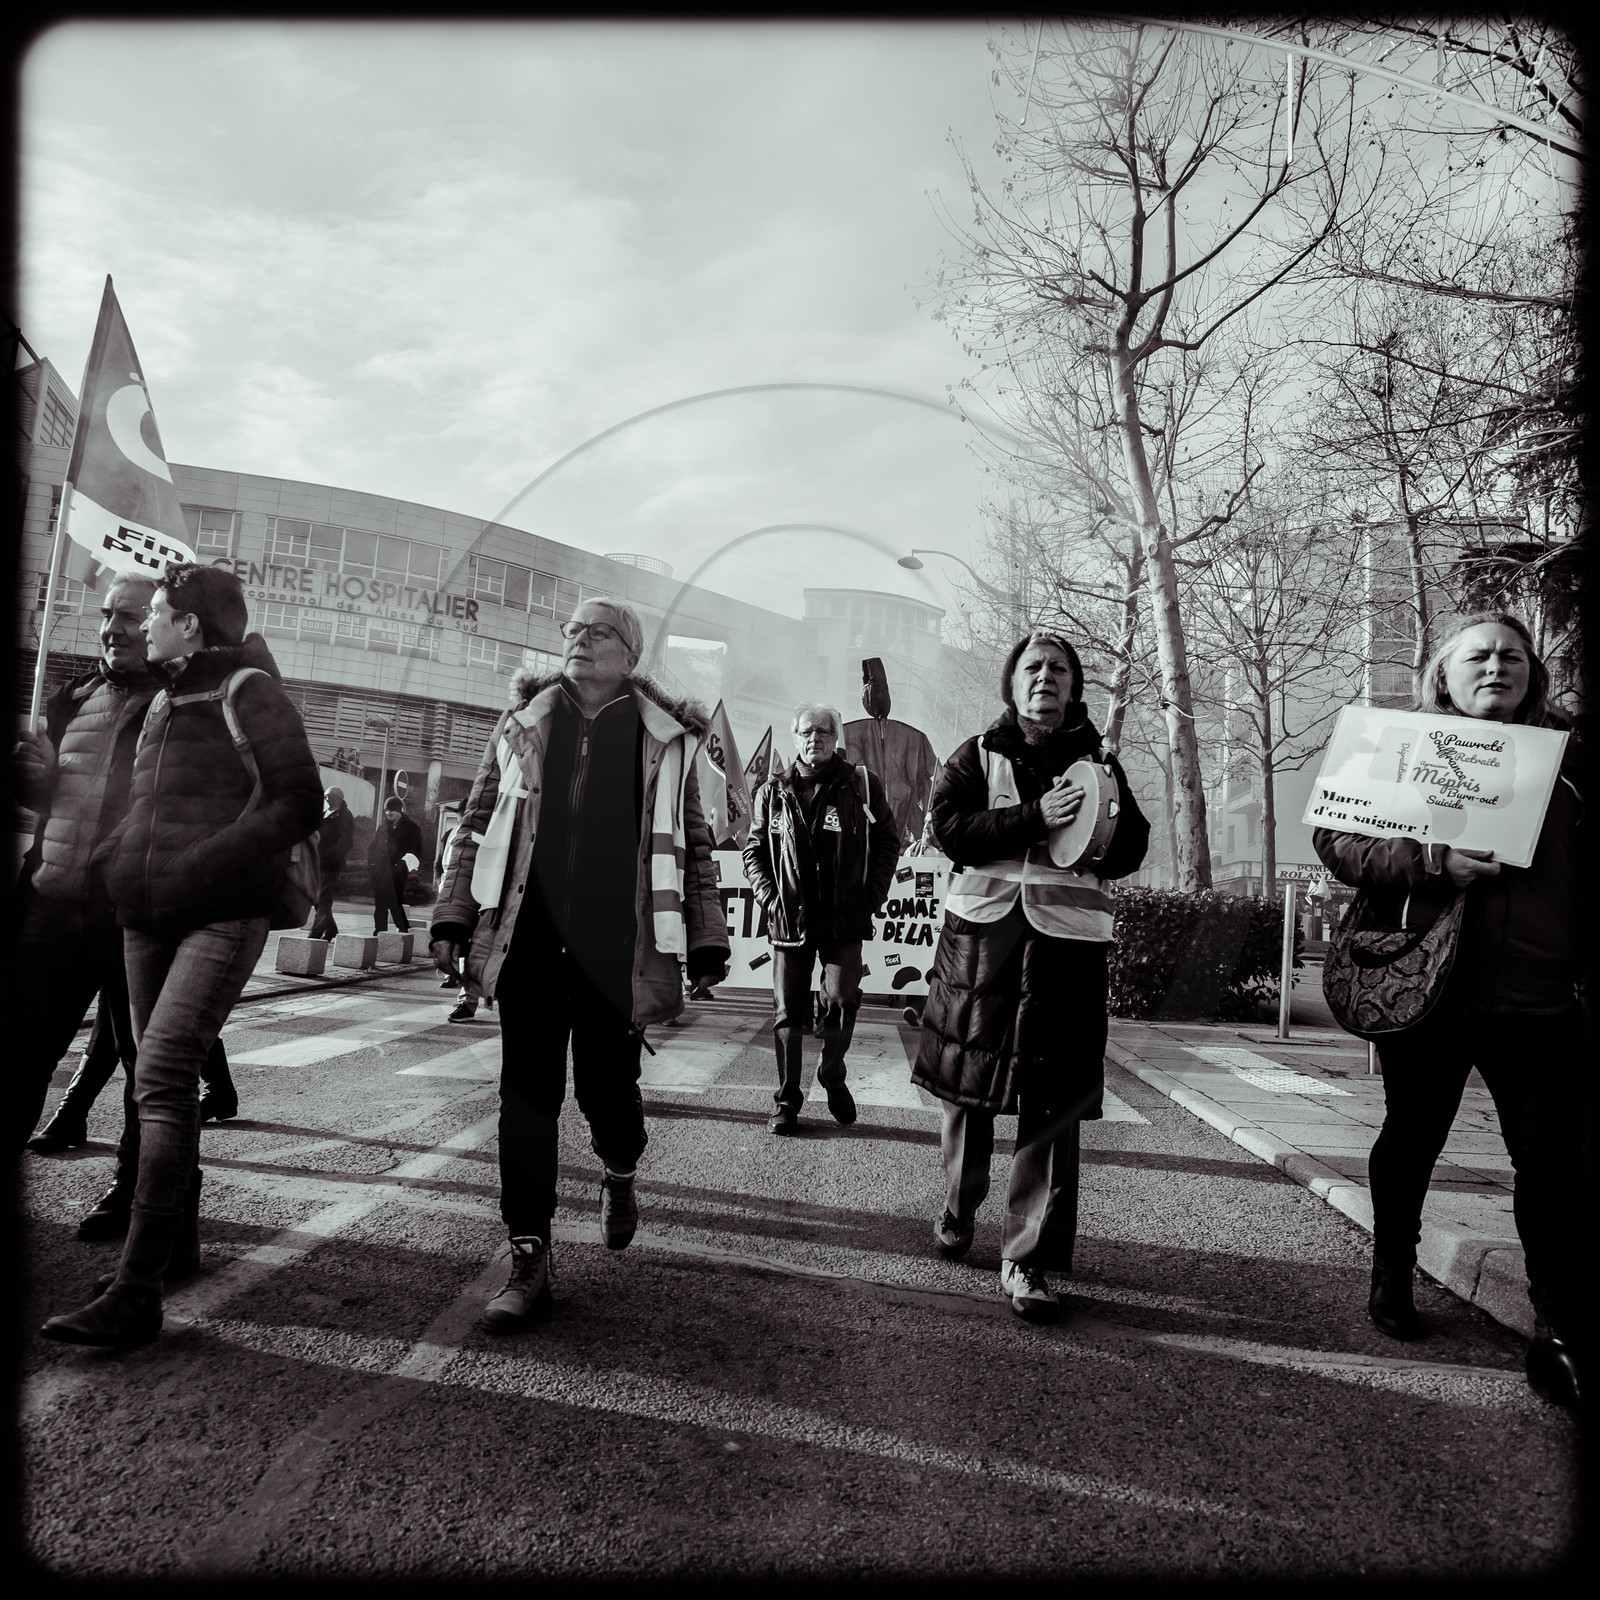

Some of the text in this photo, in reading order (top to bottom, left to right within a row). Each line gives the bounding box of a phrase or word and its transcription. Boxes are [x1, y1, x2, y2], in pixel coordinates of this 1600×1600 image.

[117, 525, 184, 562] Fin
[326, 573, 479, 621] HOSPITALIER
[242, 590, 478, 633] communal des Alpes du Sud
[1429, 730, 1467, 780] Souffrance
[1444, 734, 1506, 753] Pauvreté
[1455, 752, 1501, 768] Retraite
[1413, 767, 1480, 794] Mépris
[1319, 790, 1372, 807] Marre
[1427, 795, 1464, 810] Suicide
[1447, 788, 1499, 805] Burn-out
[1313, 806, 1347, 819] d'en
[1353, 815, 1417, 833] saigner
